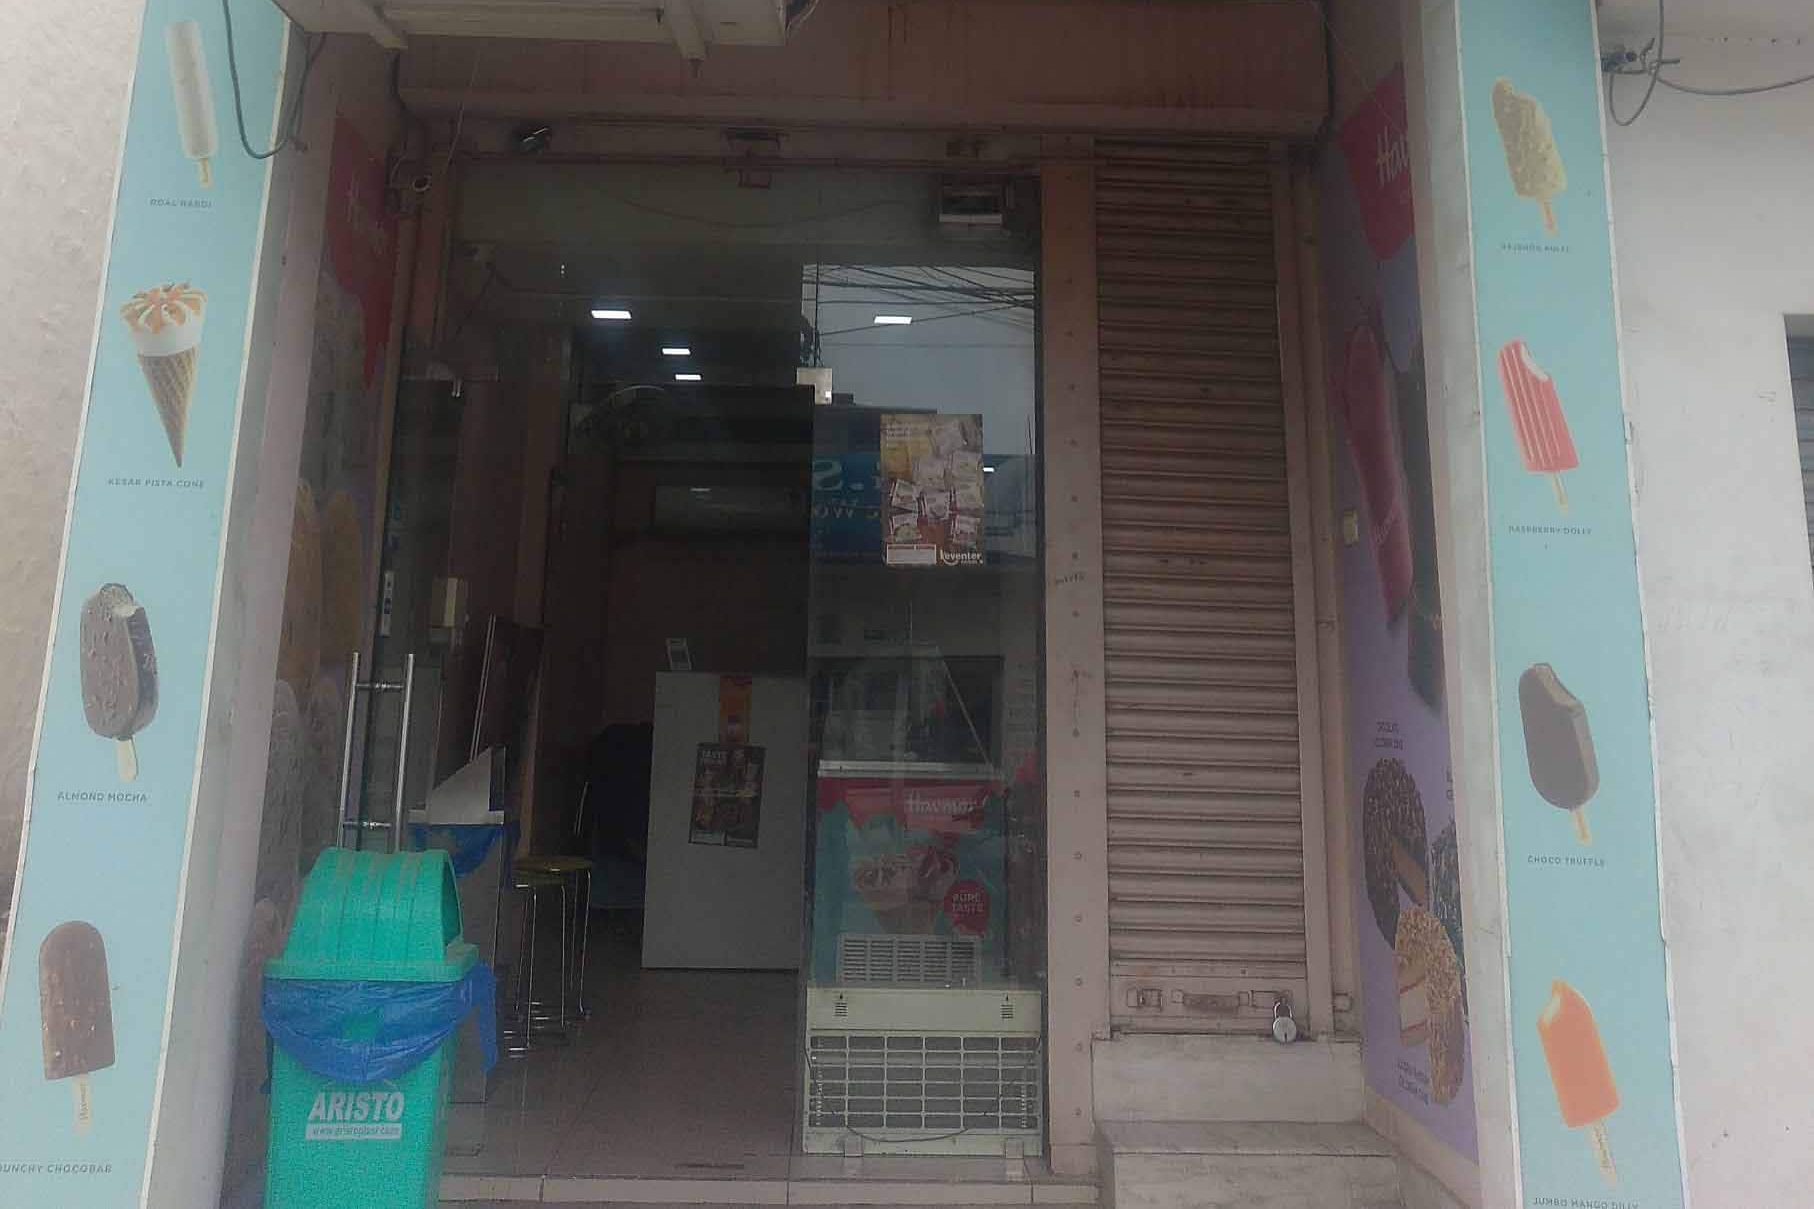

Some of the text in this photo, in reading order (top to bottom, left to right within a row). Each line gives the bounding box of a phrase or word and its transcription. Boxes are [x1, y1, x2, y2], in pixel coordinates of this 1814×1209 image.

[57, 791, 147, 803] ALMOND MOCHA
[1527, 854, 1561, 864] CHOCO
[308, 1092, 405, 1120] ARISTO
[47, 1163, 112, 1174] CHOCOBAR
[1533, 1197, 1568, 1207] JUMBO
